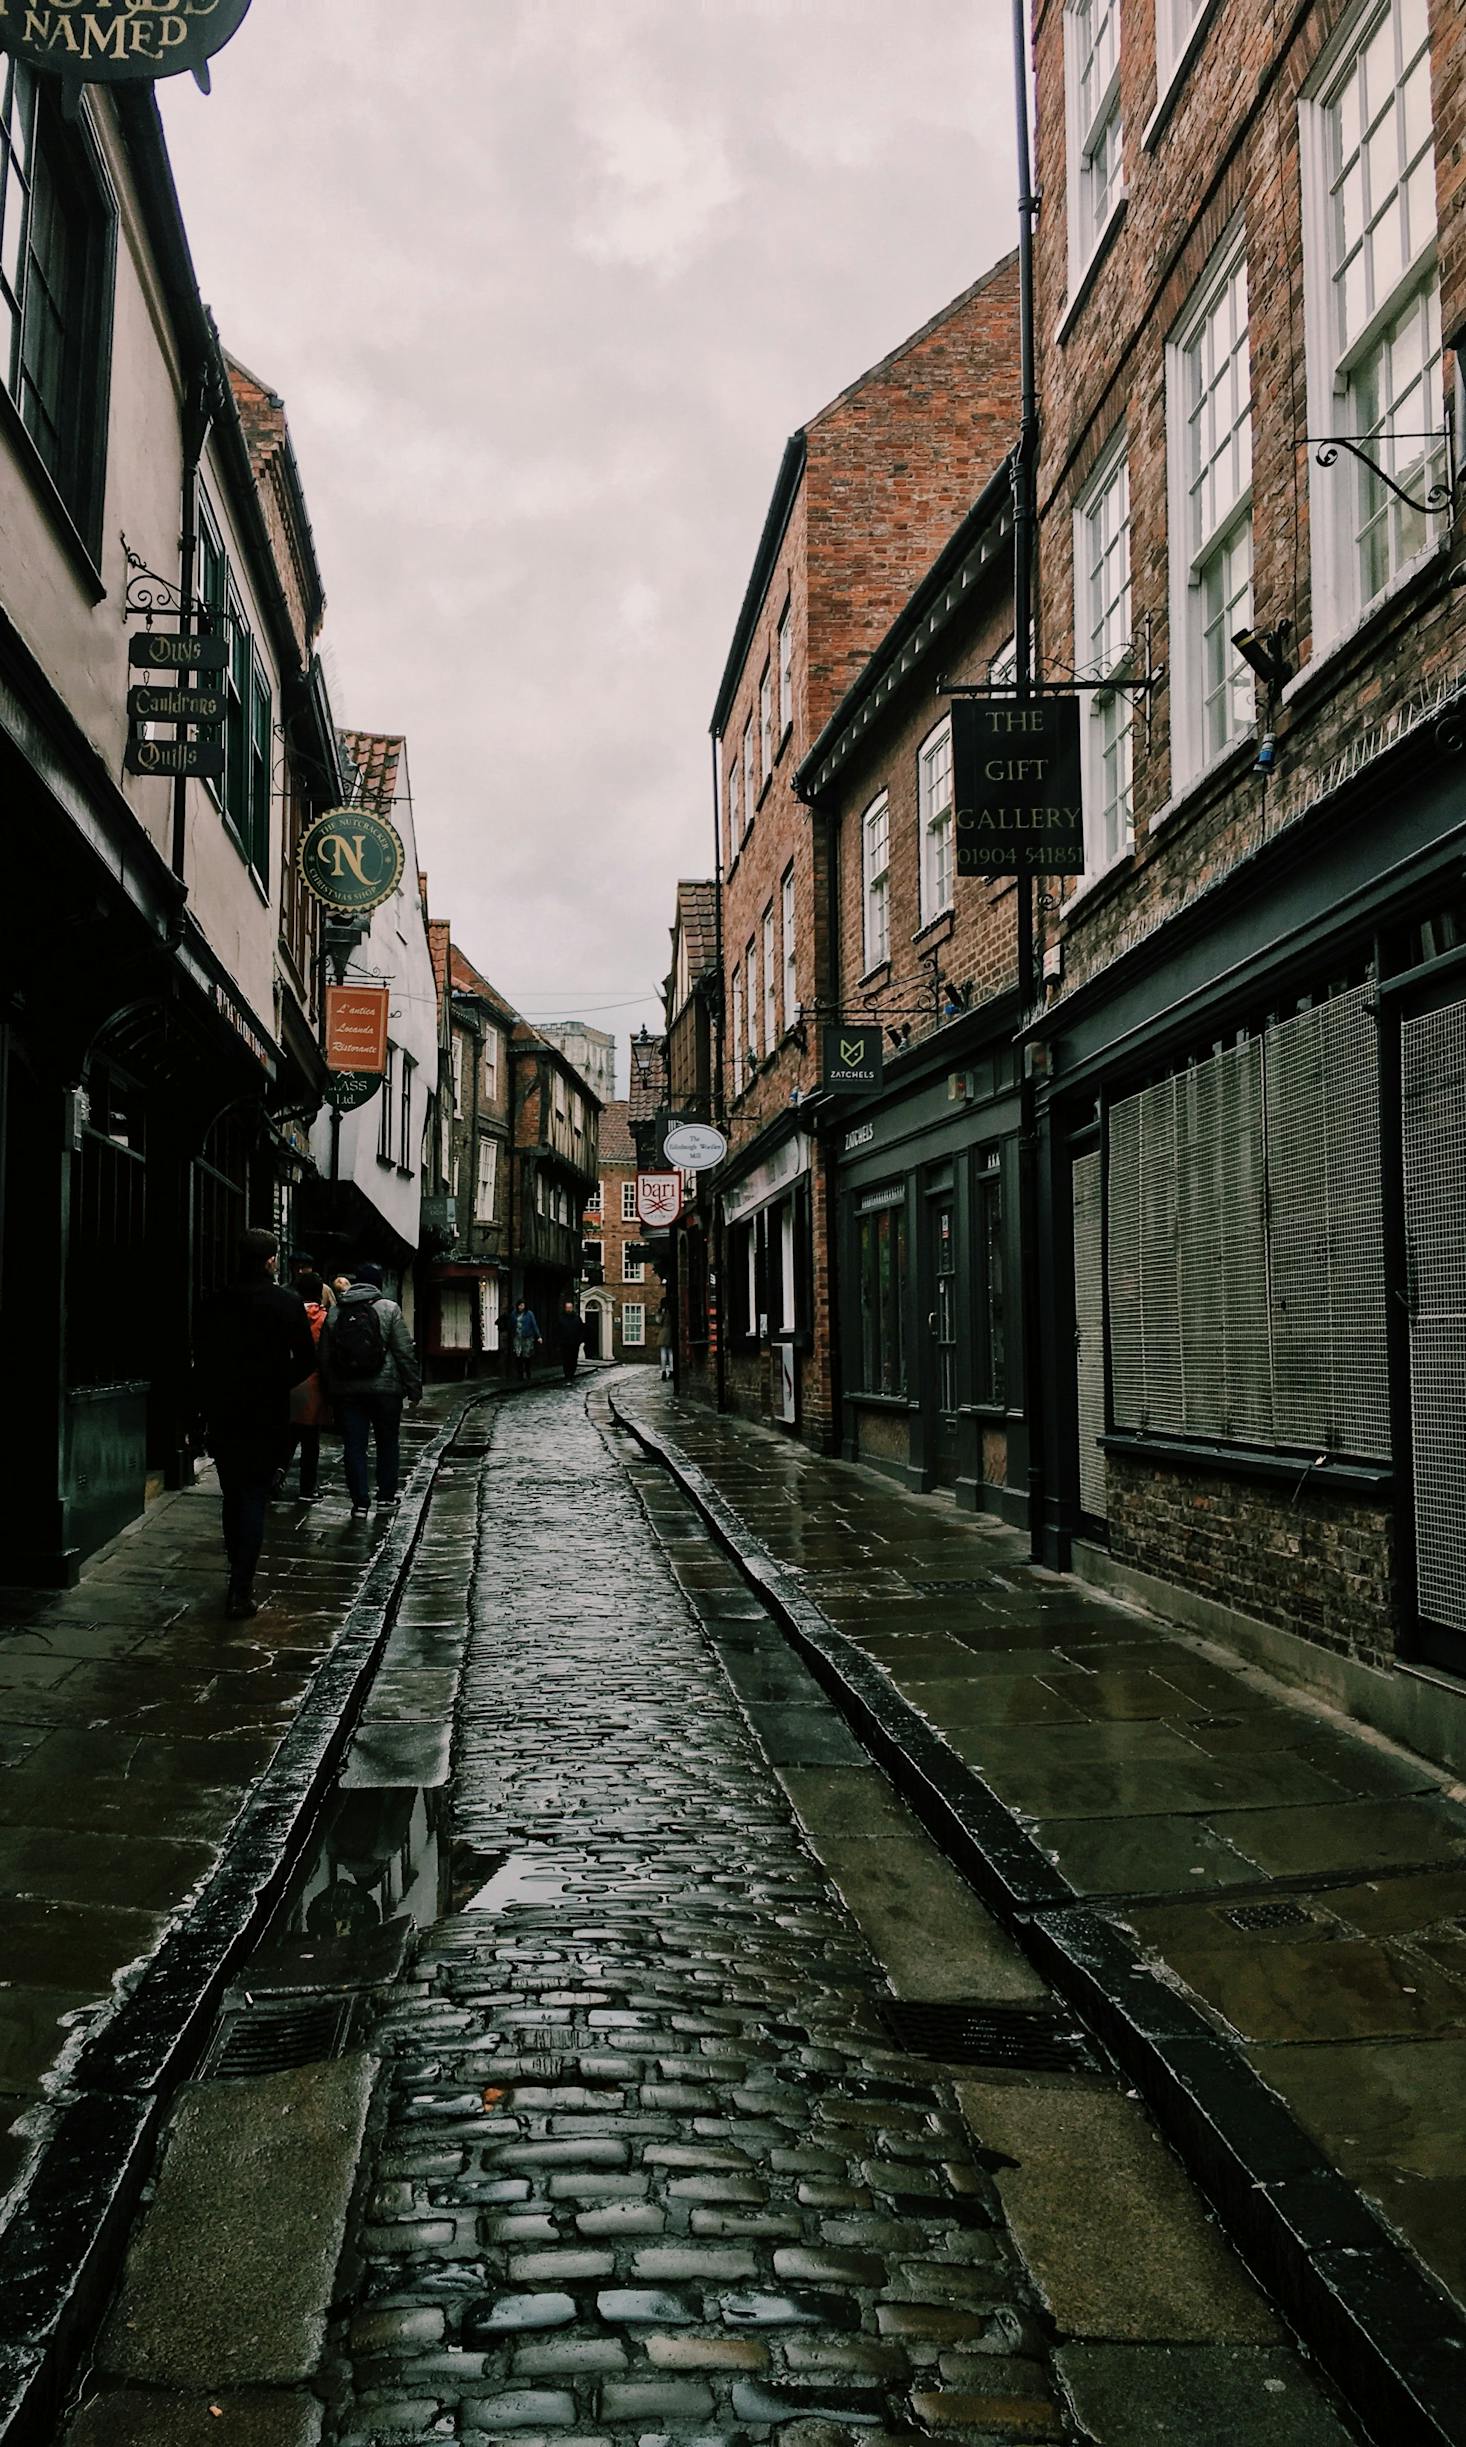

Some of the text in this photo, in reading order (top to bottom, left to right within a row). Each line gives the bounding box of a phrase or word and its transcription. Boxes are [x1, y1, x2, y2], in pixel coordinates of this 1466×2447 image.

[22, 10, 188, 59] NAMED
[136, 689, 217, 716] Cauldrons
[985, 710, 1044, 732] THE
[138, 742, 198, 773] Quills
[985, 759, 1049, 780] GIFT
[956, 807, 1081, 830] GALLERY
[320, 818, 390, 849] THE NUTCRACKER
[317, 834, 382, 886] N
[958, 846, 1083, 864] 01904 541851
[309, 868, 377, 901] CHRISTMAS SHOP
[335, 1022, 375, 1035] Locanda
[332, 1041, 377, 1054] Ristorante
[830, 1071, 875, 1079] ZATCHELS
[642, 1178, 676, 1199] bari
